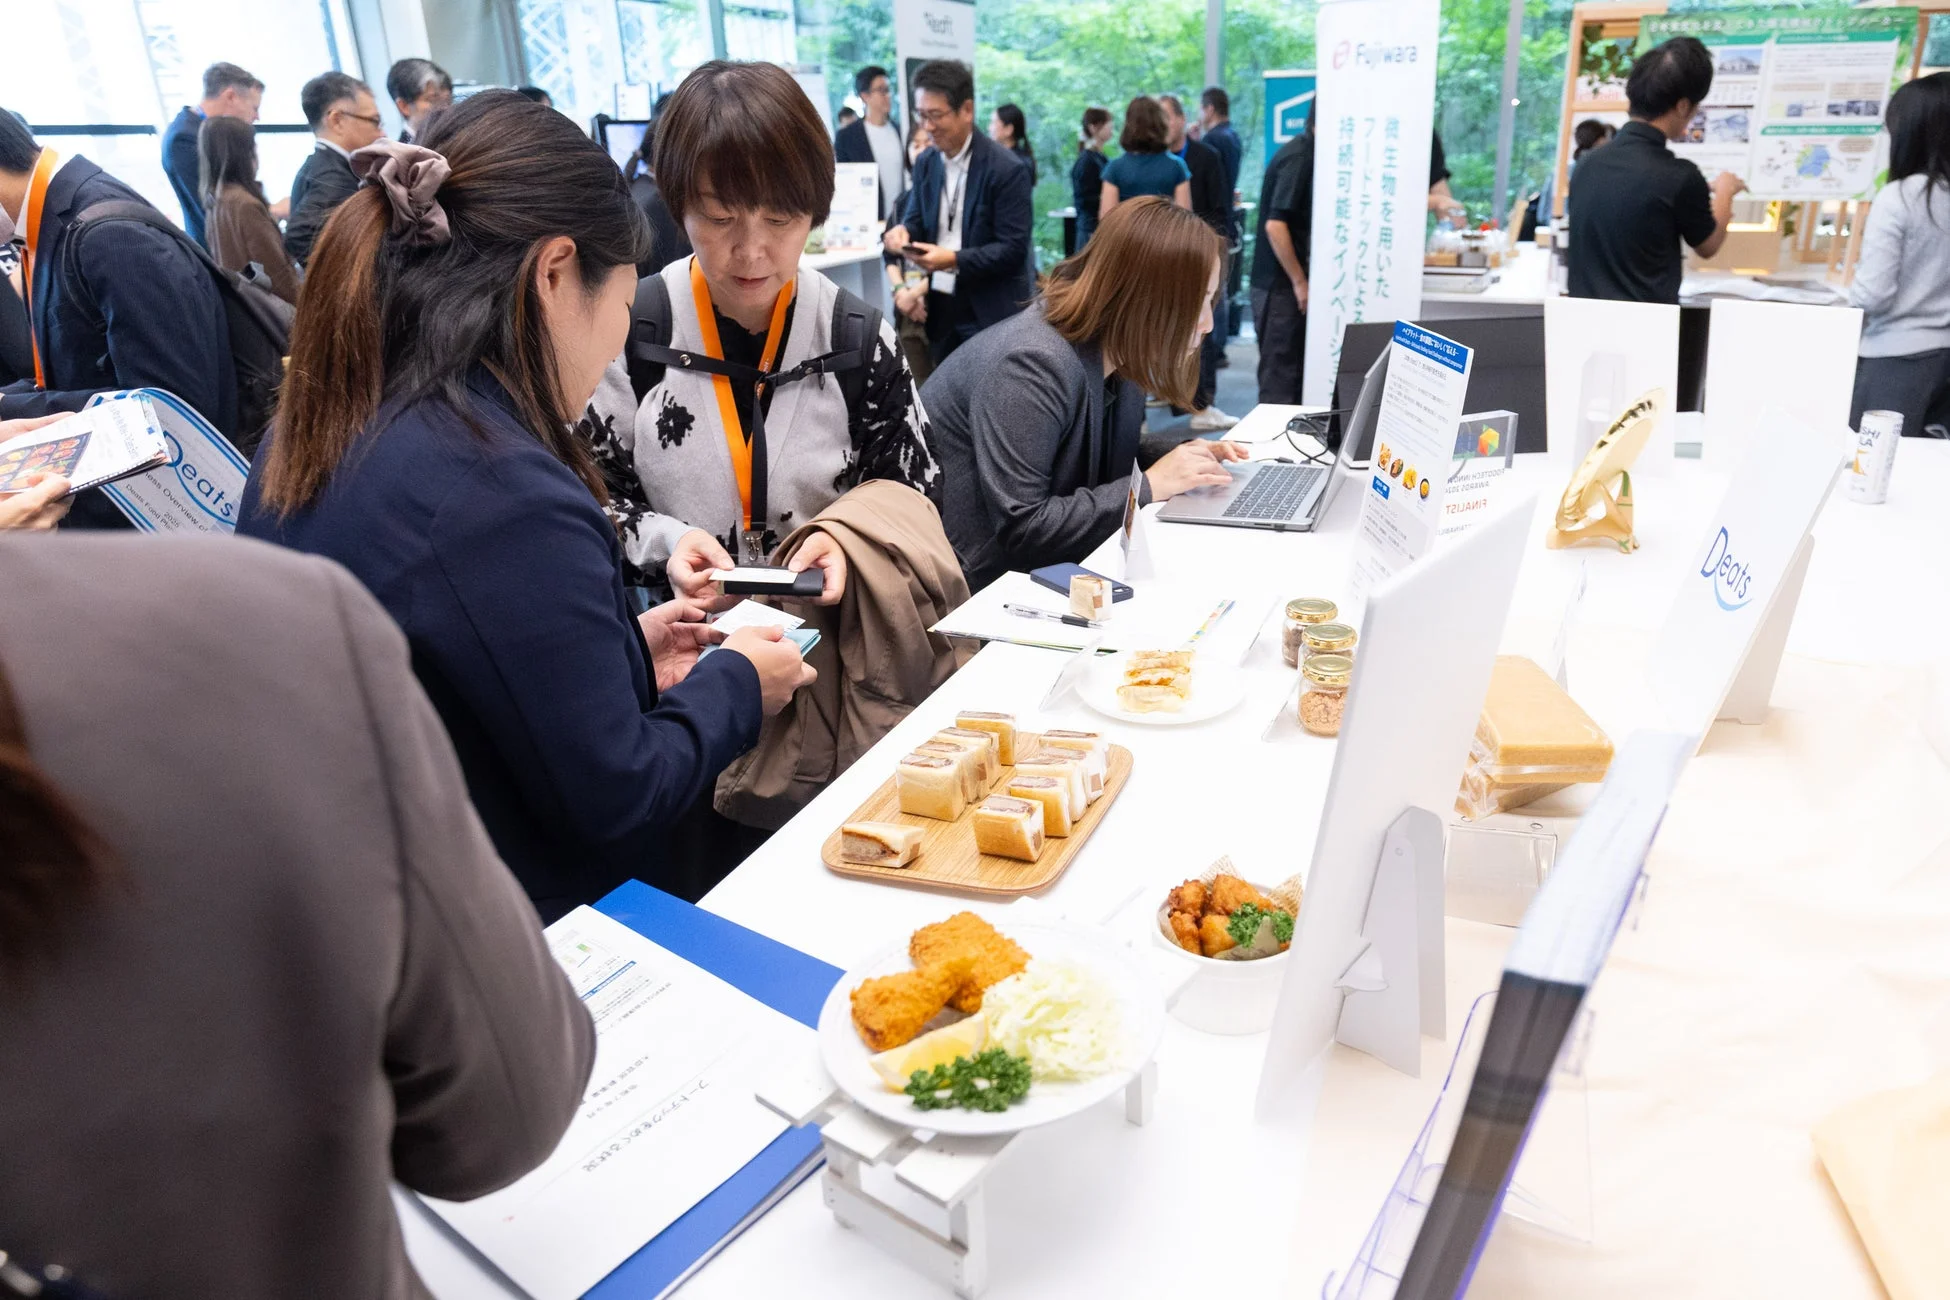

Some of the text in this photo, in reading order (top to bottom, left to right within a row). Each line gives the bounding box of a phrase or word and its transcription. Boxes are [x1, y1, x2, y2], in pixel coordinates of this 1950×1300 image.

[1356, 42, 1417, 70] Fujiwara
[1374, 117, 1400, 298] 微生物を用いた
[144, 502, 162, 521] Food
[163, 488, 200, 526] Overview
[1701, 526, 1751, 600] Deats
